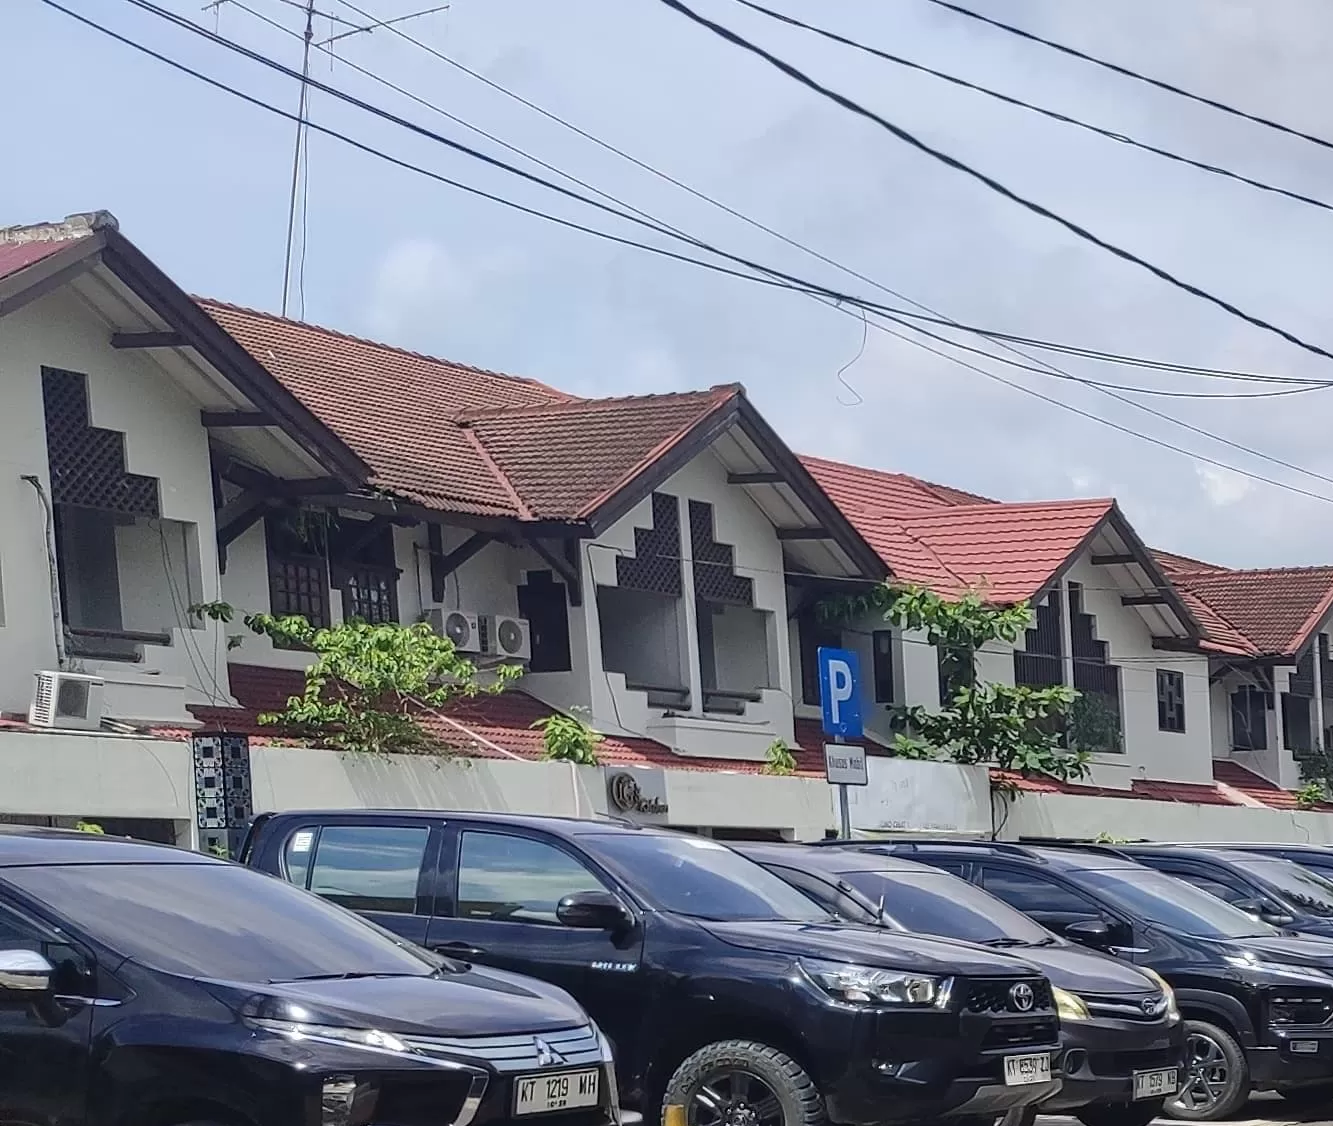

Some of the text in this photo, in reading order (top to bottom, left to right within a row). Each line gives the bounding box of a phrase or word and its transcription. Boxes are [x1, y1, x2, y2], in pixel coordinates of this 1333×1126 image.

[828, 660, 853, 724] P
[520, 1080, 537, 1102] KT
[546, 1077, 569, 1099] 1219
